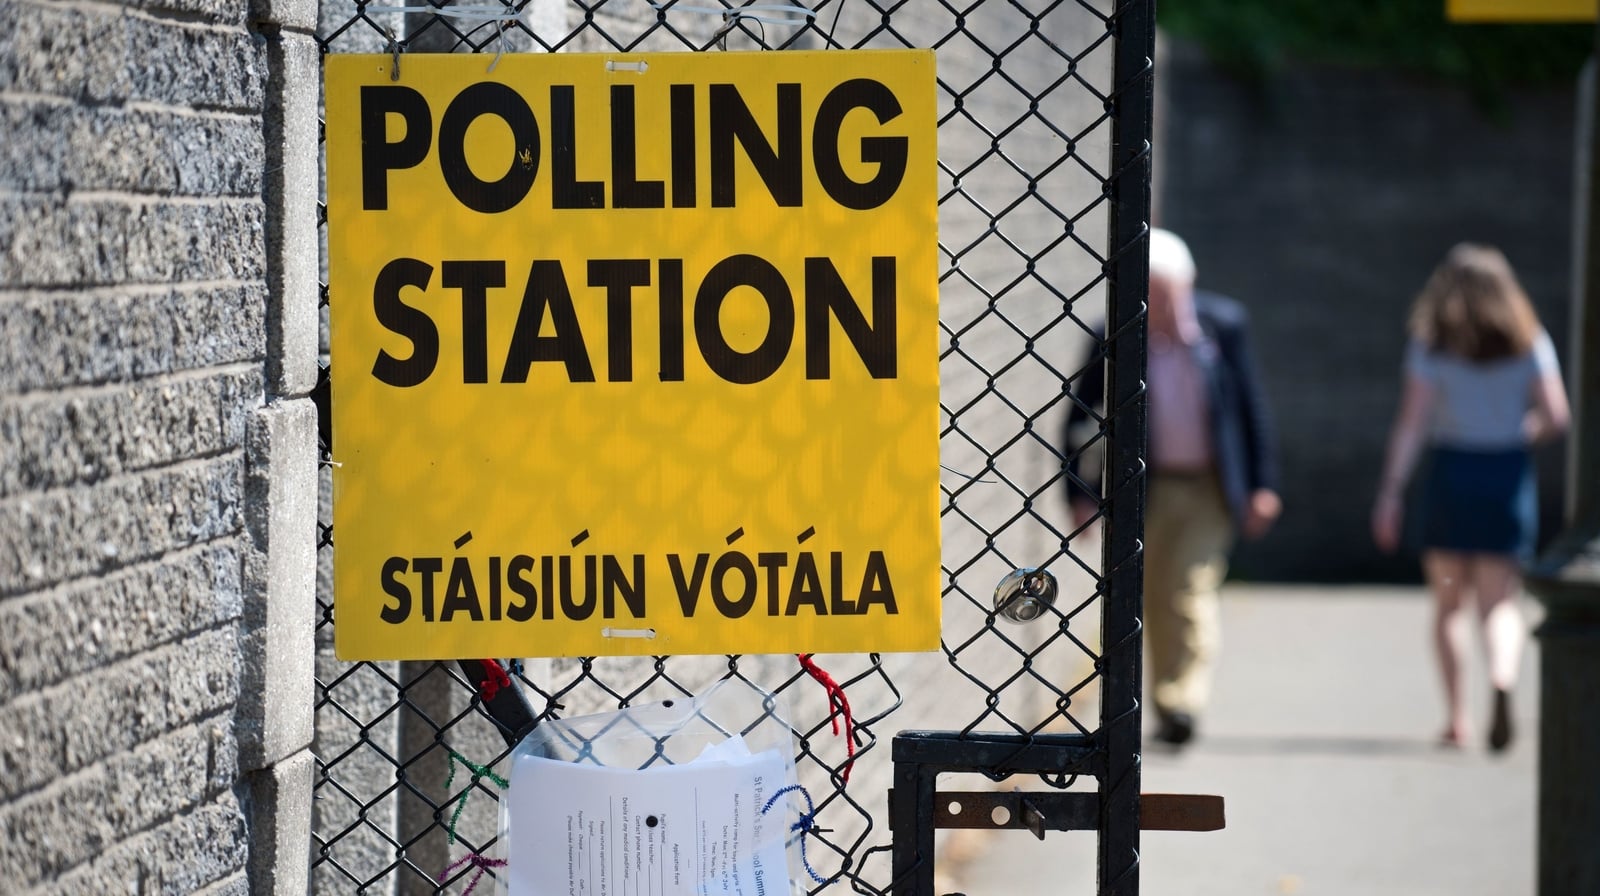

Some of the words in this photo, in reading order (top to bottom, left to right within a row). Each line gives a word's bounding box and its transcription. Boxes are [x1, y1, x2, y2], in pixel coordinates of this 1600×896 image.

[361, 79, 908, 213] POLLING
[372, 254, 897, 387] STATION
[380, 530, 645, 624] STÁISIÚN
[667, 527, 898, 618] VÓTÁLA
[753, 776, 763, 786] St
[753, 787, 763, 824] Patrick's
[634, 836, 642, 850] phone
